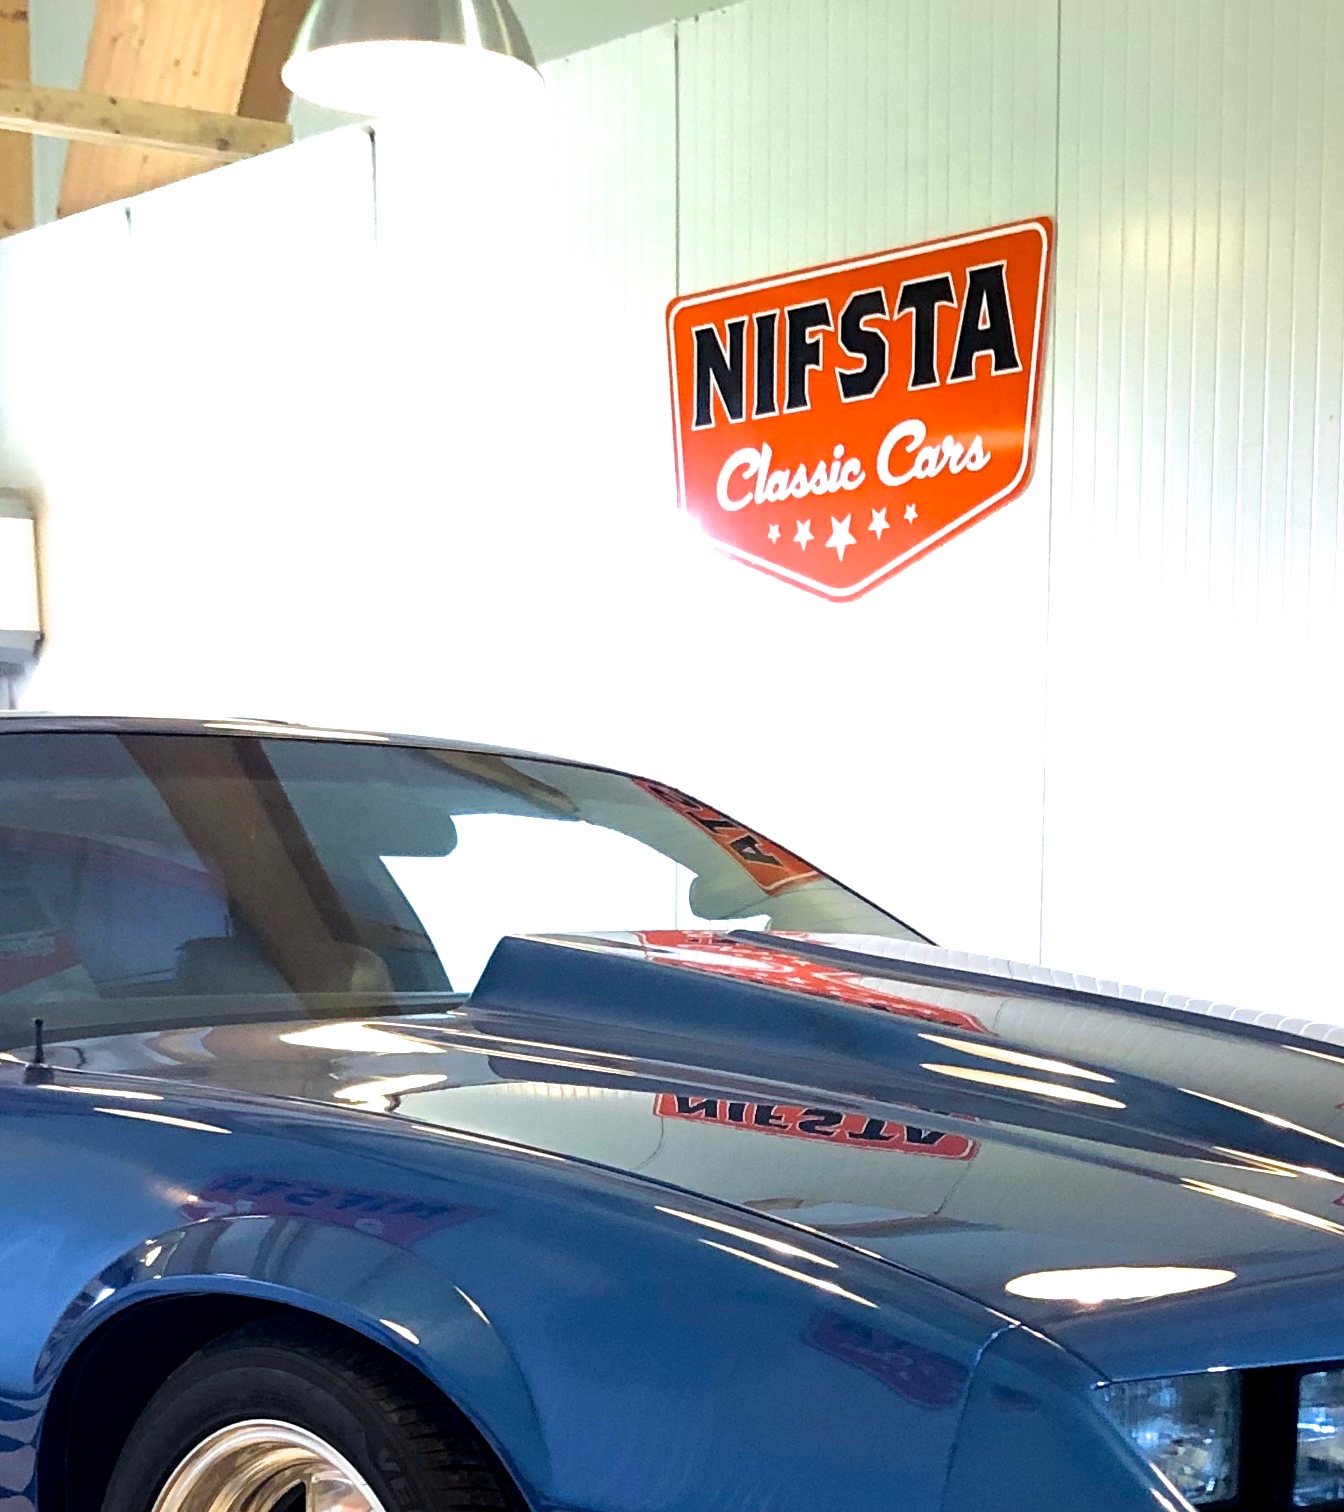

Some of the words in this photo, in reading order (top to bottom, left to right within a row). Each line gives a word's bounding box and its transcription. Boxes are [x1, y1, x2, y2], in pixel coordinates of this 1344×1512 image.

[691, 260, 1023, 431] NIFSTA
[717, 443, 865, 511] Classic
[877, 419, 990, 486] Cars
